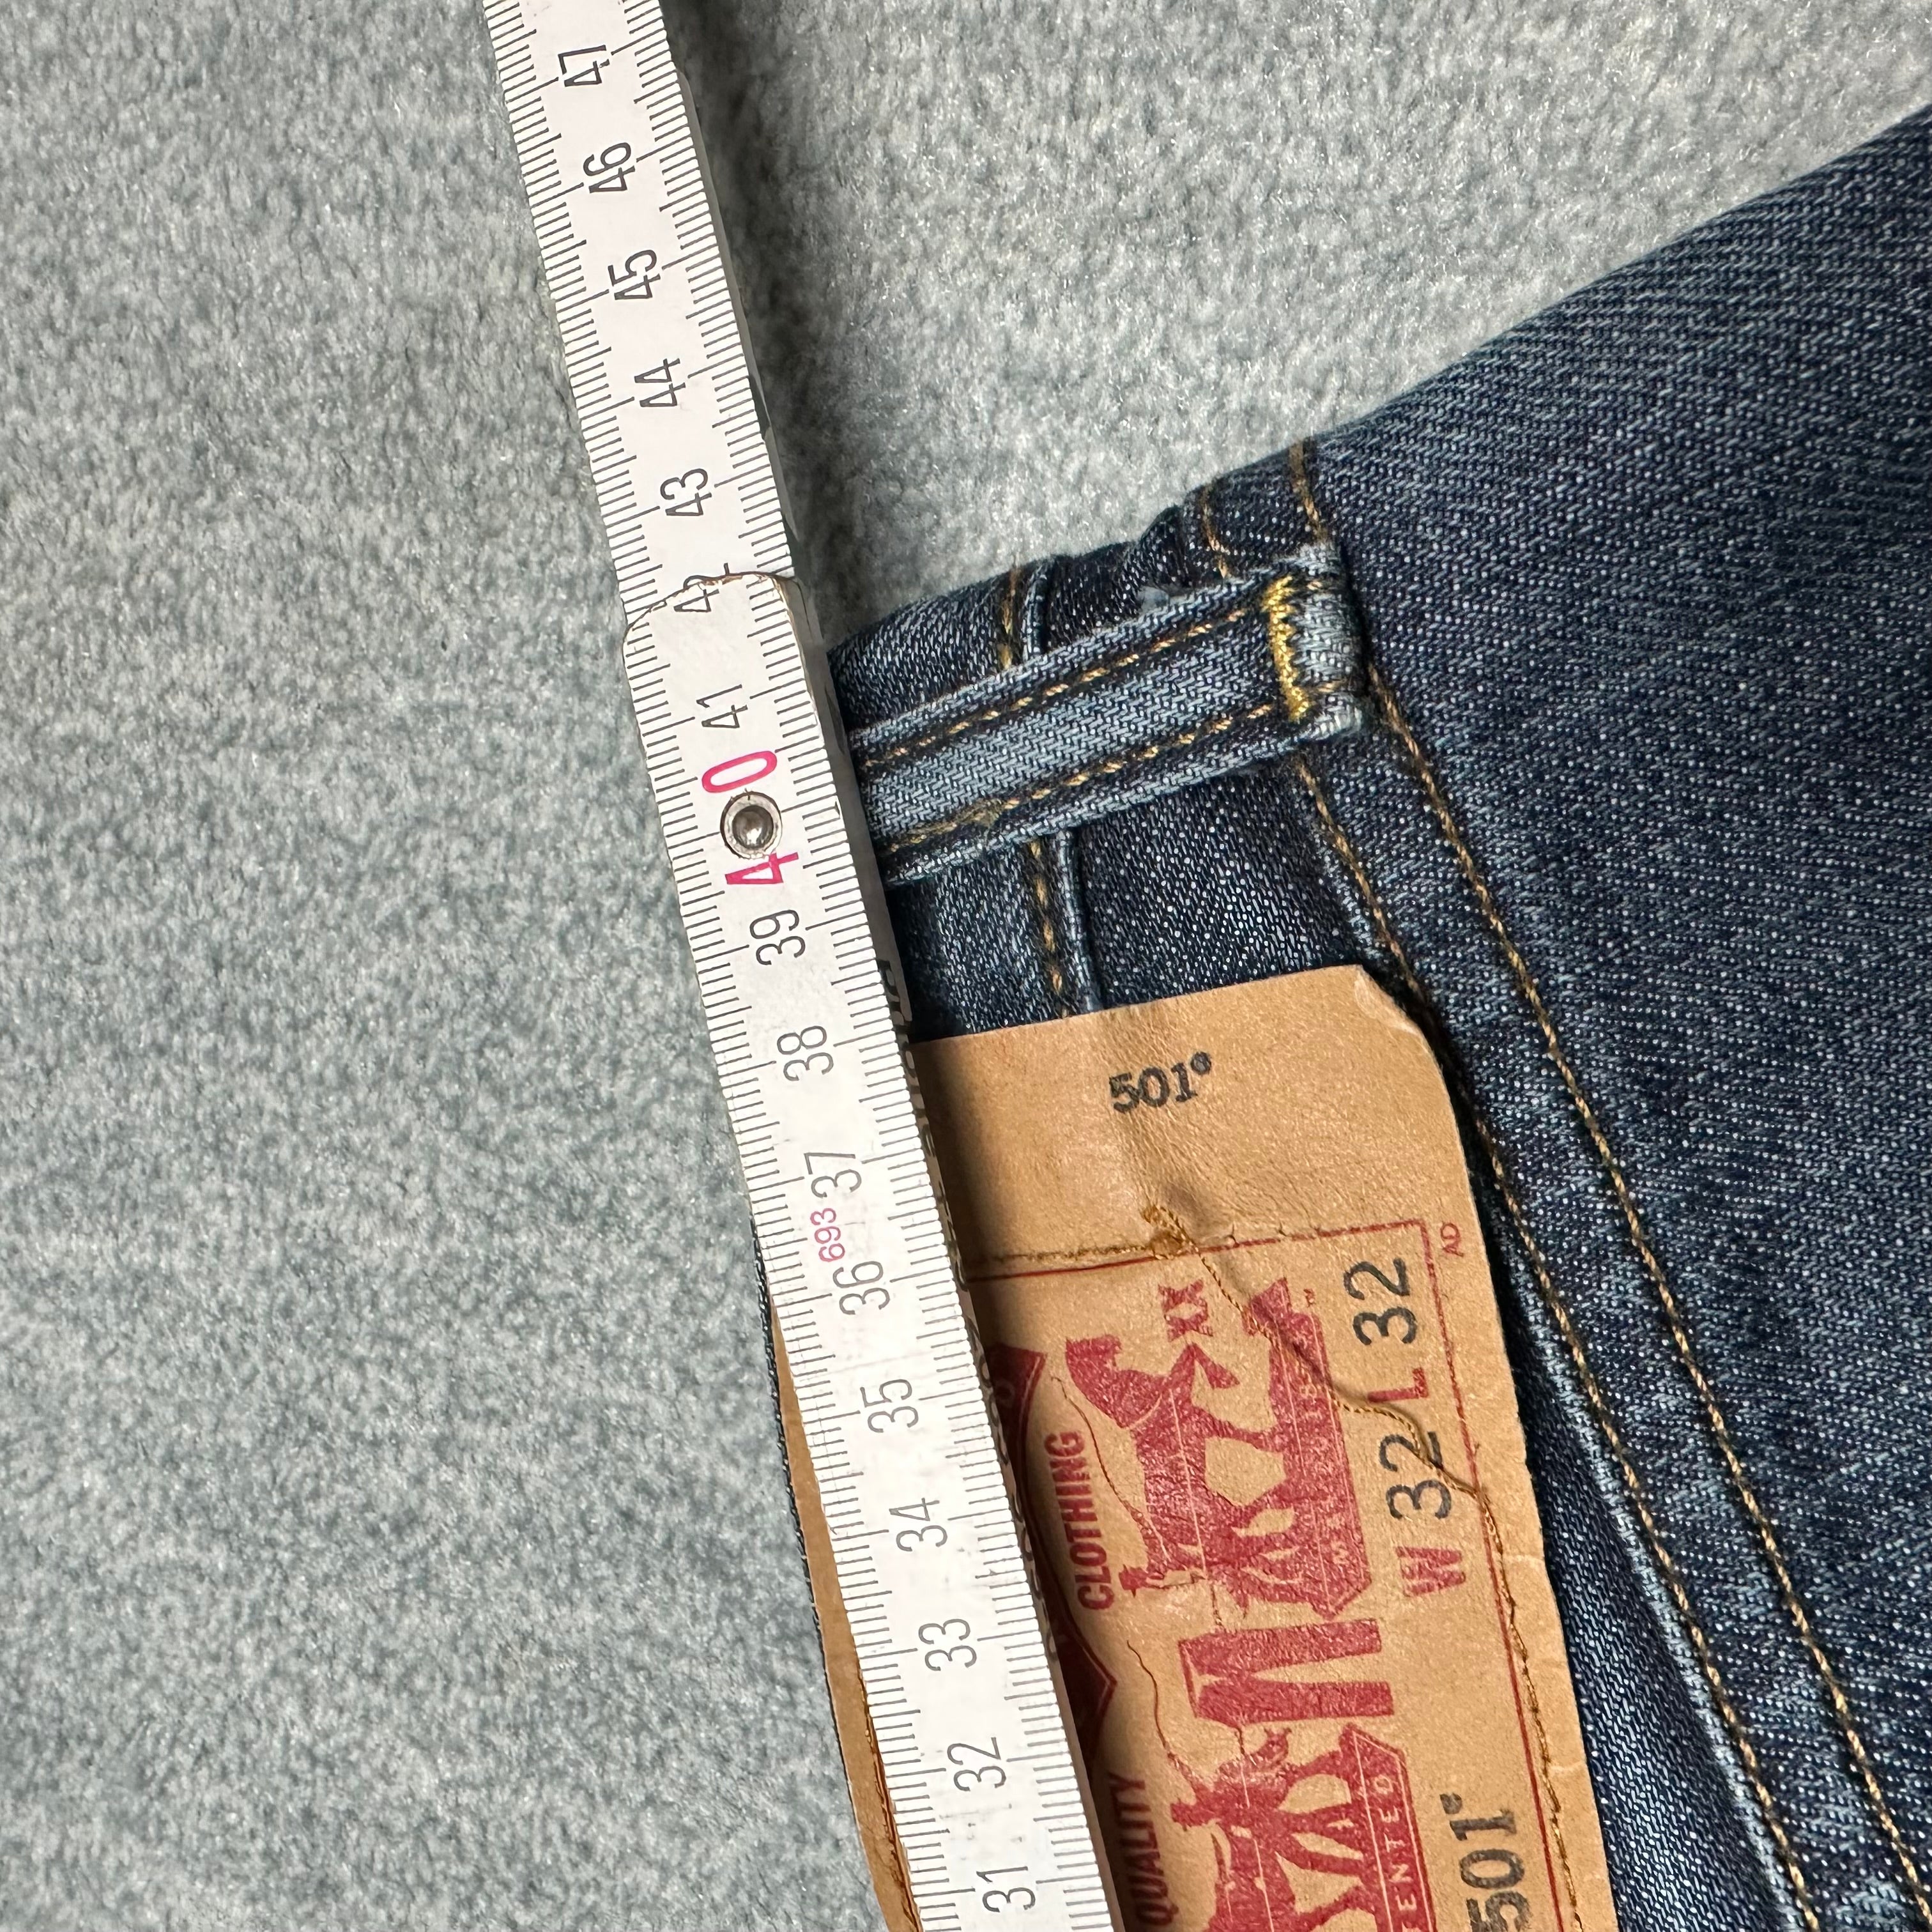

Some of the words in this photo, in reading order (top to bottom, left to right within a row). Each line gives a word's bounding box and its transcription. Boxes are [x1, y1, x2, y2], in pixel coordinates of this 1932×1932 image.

[558, 45, 610, 87] 47
[582, 142, 636, 194] 46
[608, 249, 661, 300] 45
[634, 358, 686, 408] 44
[660, 468, 712, 516] 43
[696, 684, 748, 728] 41
[702, 750, 799, 885] 40
[749, 909, 806, 965] 39
[776, 1025, 834, 1082] 38
[804, 1152, 862, 1199] 37
[809, 1207, 845, 1262] 693
[832, 1260, 890, 1315] 36
[1157, 1279, 1213, 1342] XX
[1343, 1257, 1417, 1346] 32
[860, 1378, 919, 1433] 35
[1367, 1367, 1429, 1402] L
[1378, 1430, 1452, 1521] 32
[889, 1498, 947, 1552] 34
[1045, 1430, 1116, 1611] CLOTHING
[1395, 1545, 1467, 1597] W
[918, 1618, 977, 1671] 33
[946, 1736, 1007, 1792] 32
[1107, 1772, 1179, 1926] QUALITY
[976, 1866, 1036, 1913] 31
